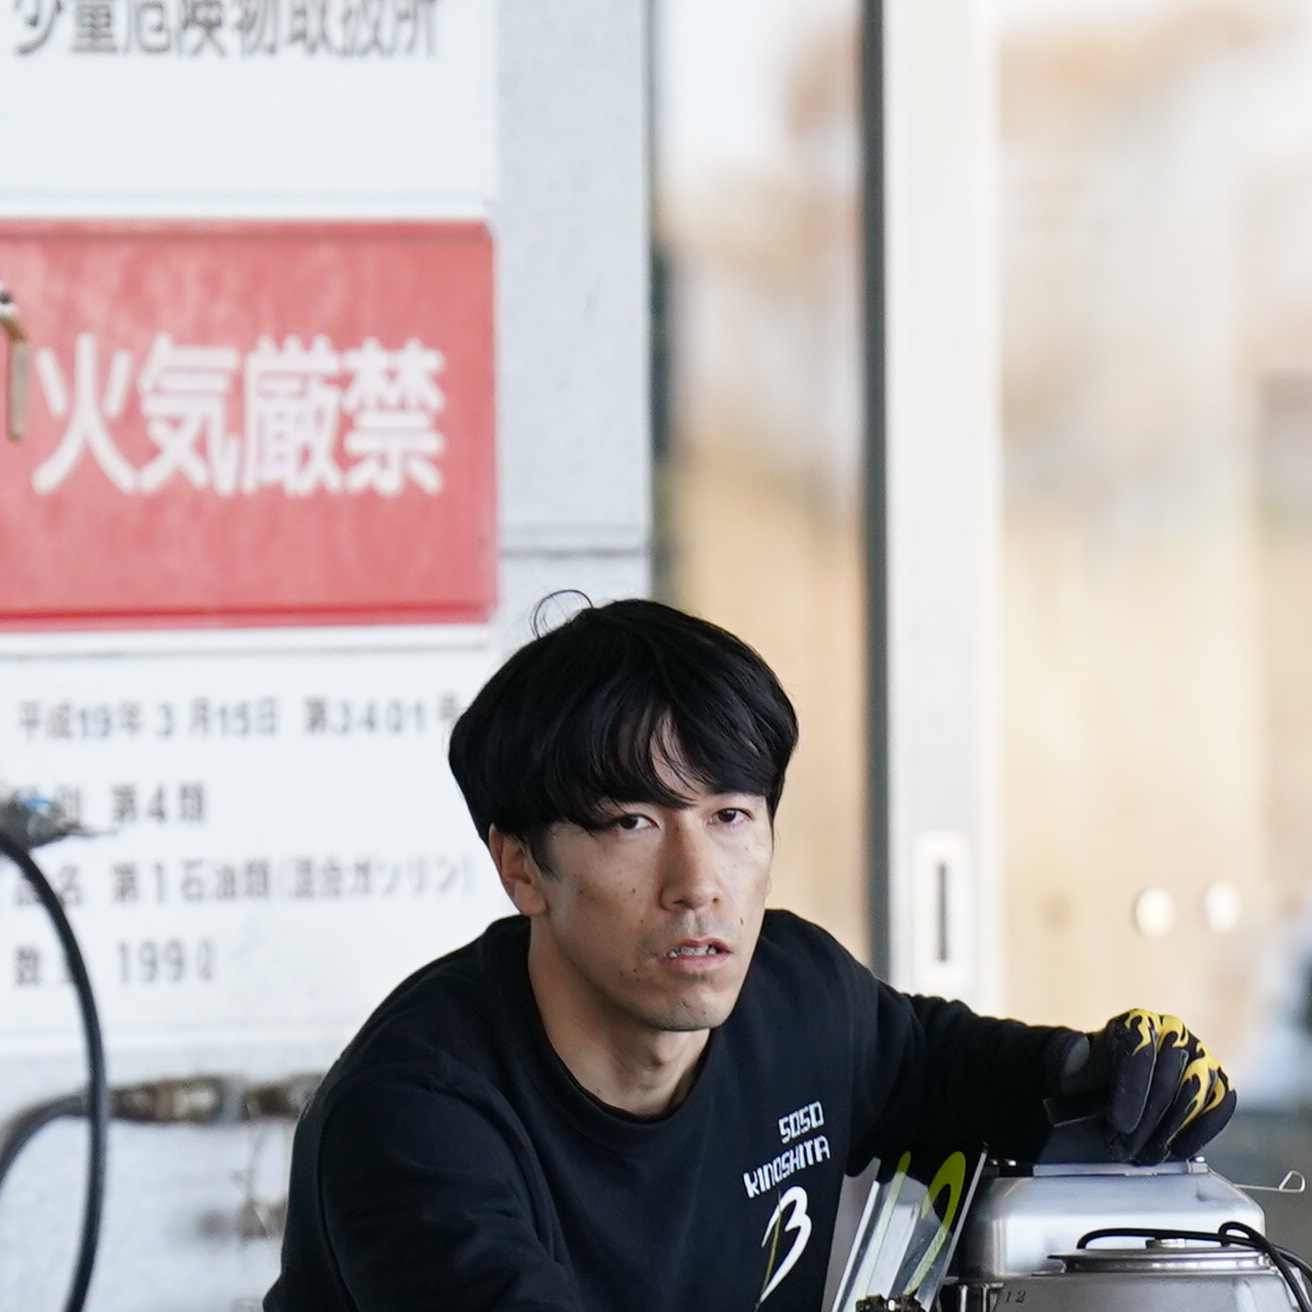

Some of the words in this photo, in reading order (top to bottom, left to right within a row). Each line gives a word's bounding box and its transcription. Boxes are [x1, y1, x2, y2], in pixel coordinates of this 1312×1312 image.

[31, 331, 446, 497] 火気厳禁
[743, 1135, 830, 1198] KINOSHITA
